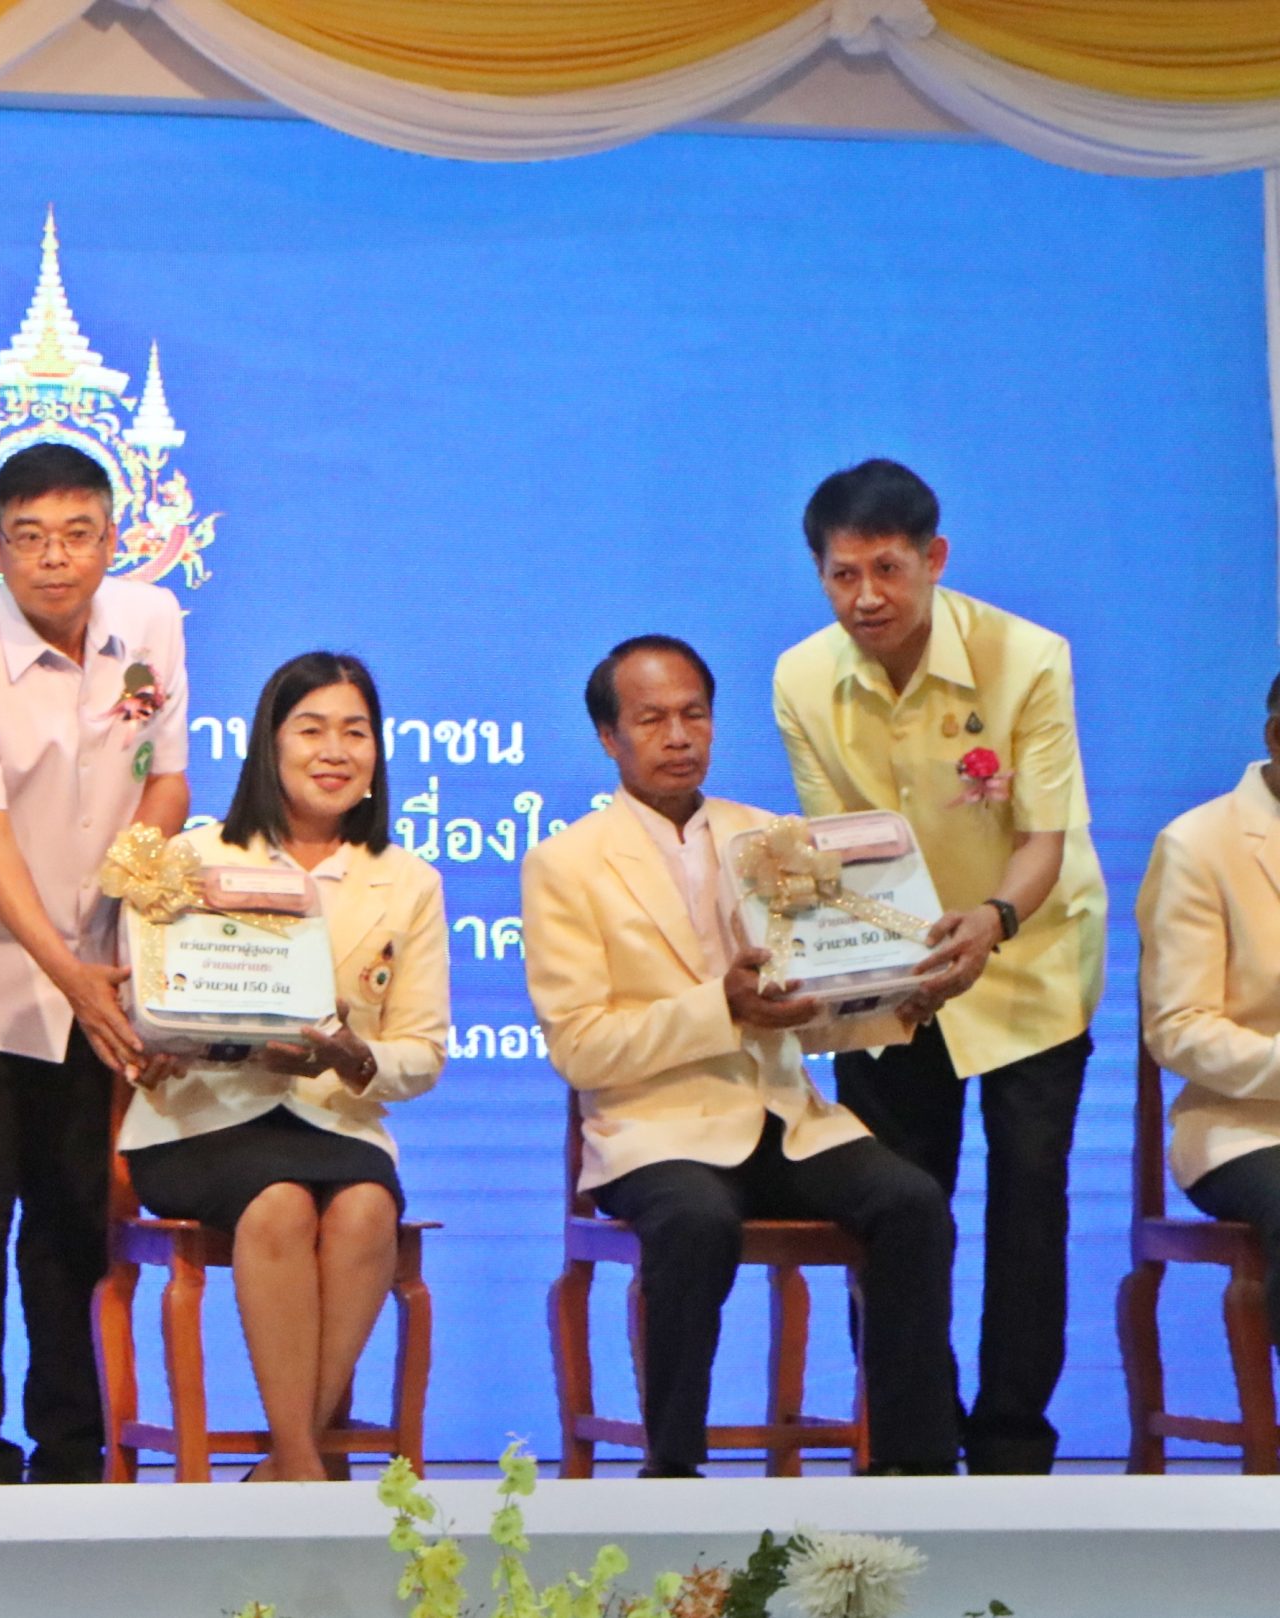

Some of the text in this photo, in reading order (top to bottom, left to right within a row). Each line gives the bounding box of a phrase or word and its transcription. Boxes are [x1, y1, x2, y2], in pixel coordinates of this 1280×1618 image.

[861, 932, 879, 945] 50
[193, 977, 291, 995] จำนวน 150 อัน
